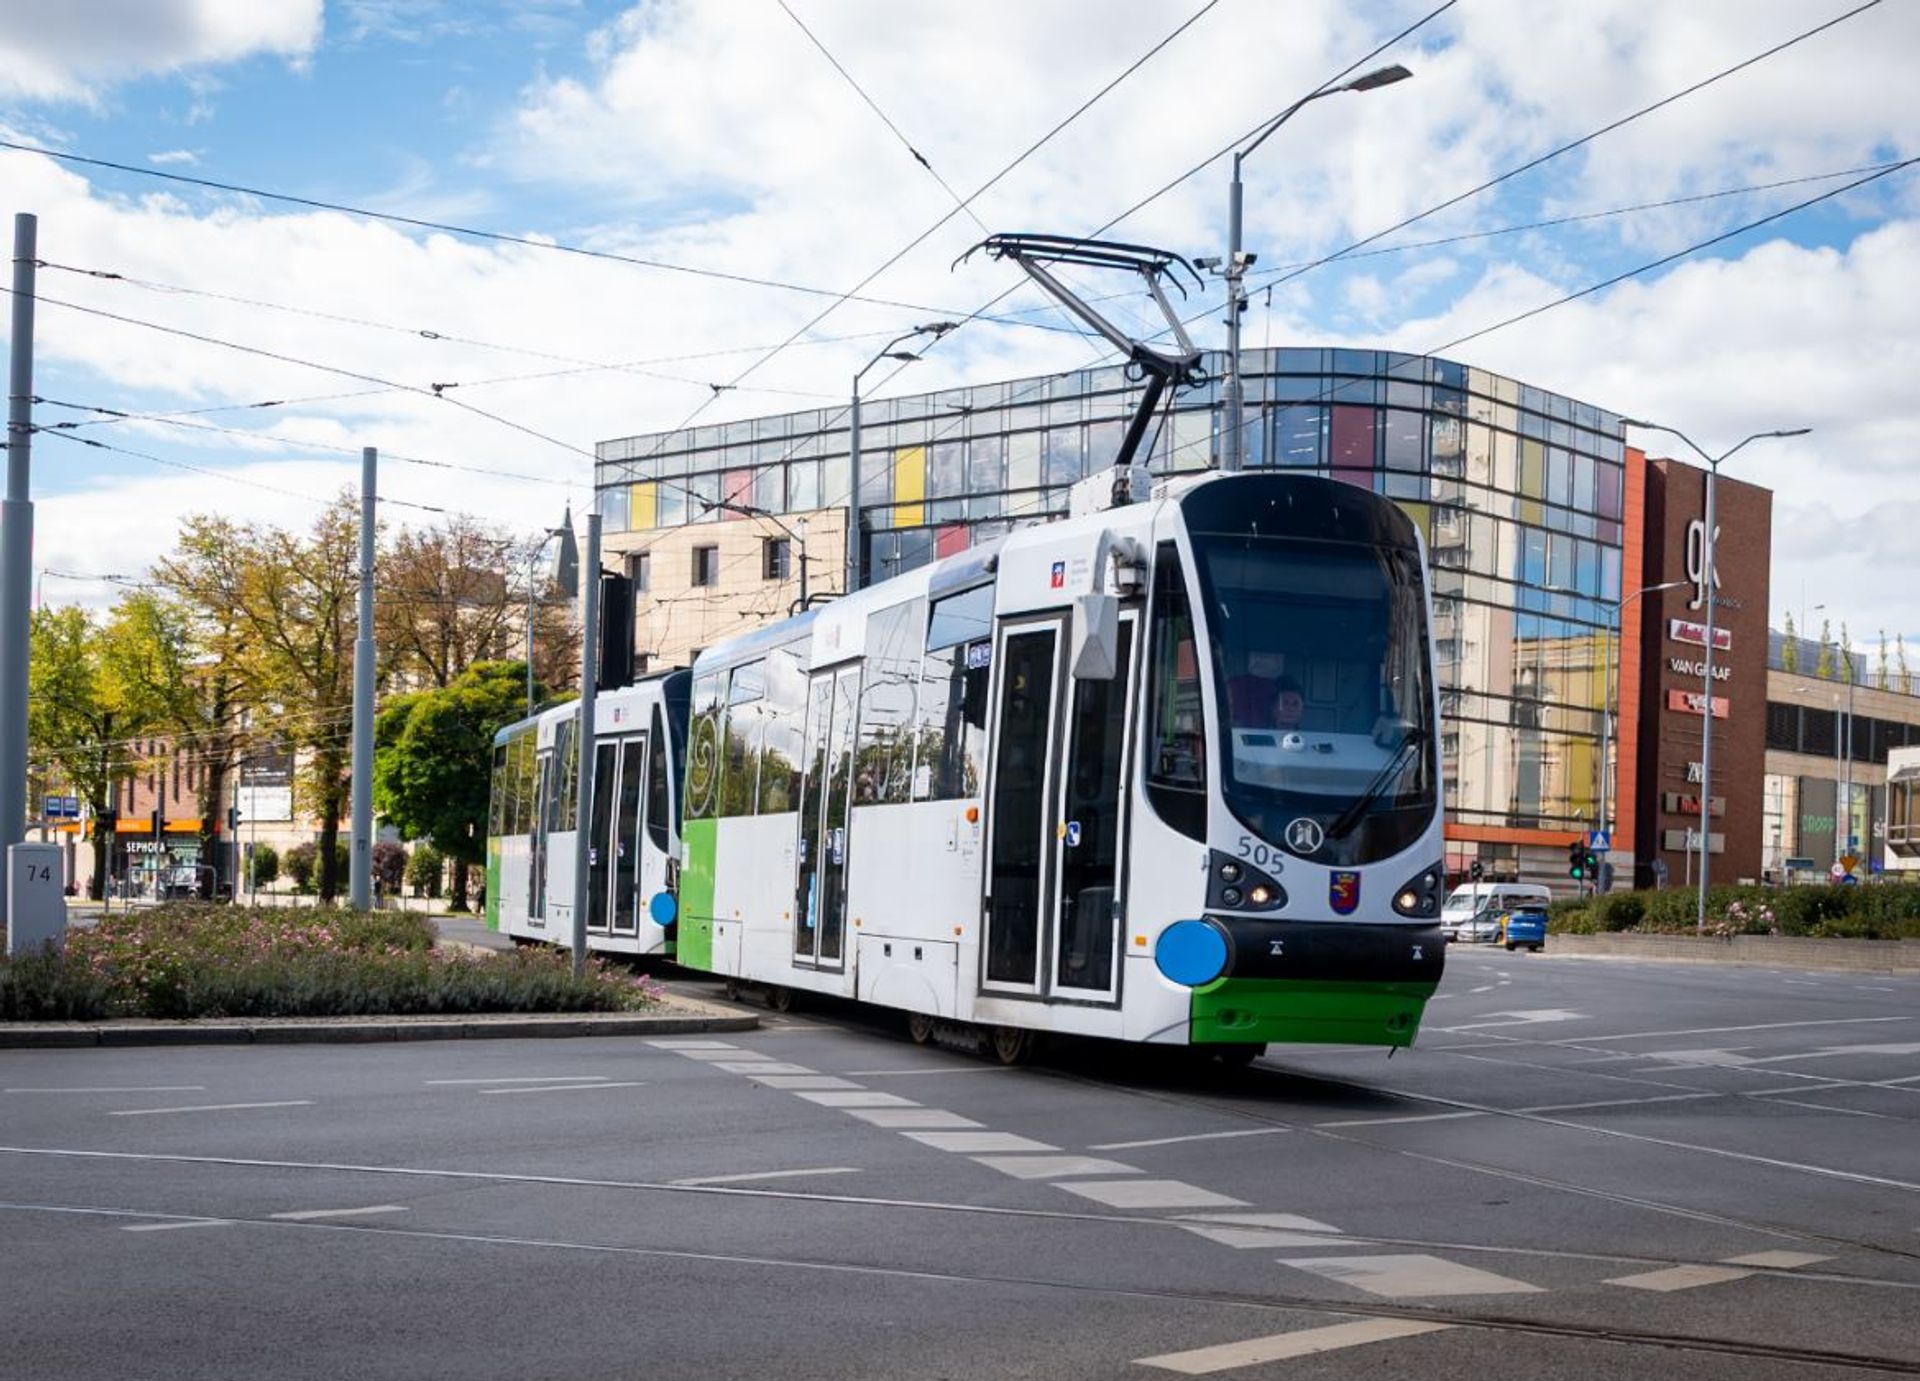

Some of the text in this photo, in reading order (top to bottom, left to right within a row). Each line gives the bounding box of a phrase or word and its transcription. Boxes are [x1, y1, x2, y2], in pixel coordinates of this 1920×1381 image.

[1671, 658, 1694, 674] VAN
[1238, 836, 1285, 875] 505
[27, 864, 51, 883] 74
